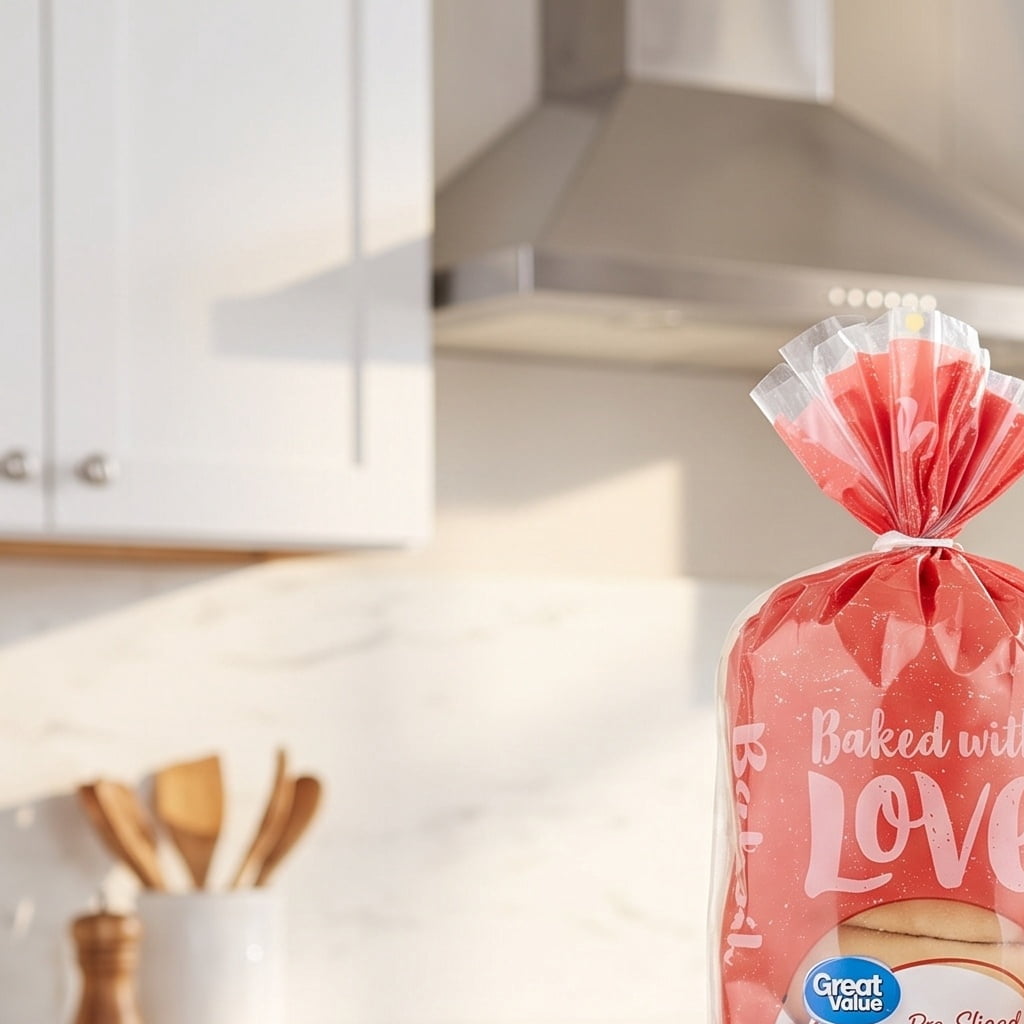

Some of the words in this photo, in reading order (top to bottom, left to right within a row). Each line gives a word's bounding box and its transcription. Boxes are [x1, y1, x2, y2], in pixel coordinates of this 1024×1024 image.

[812, 706, 951, 765] Baked
[812, 972, 884, 997] Great
[829, 995, 884, 1012] Value
